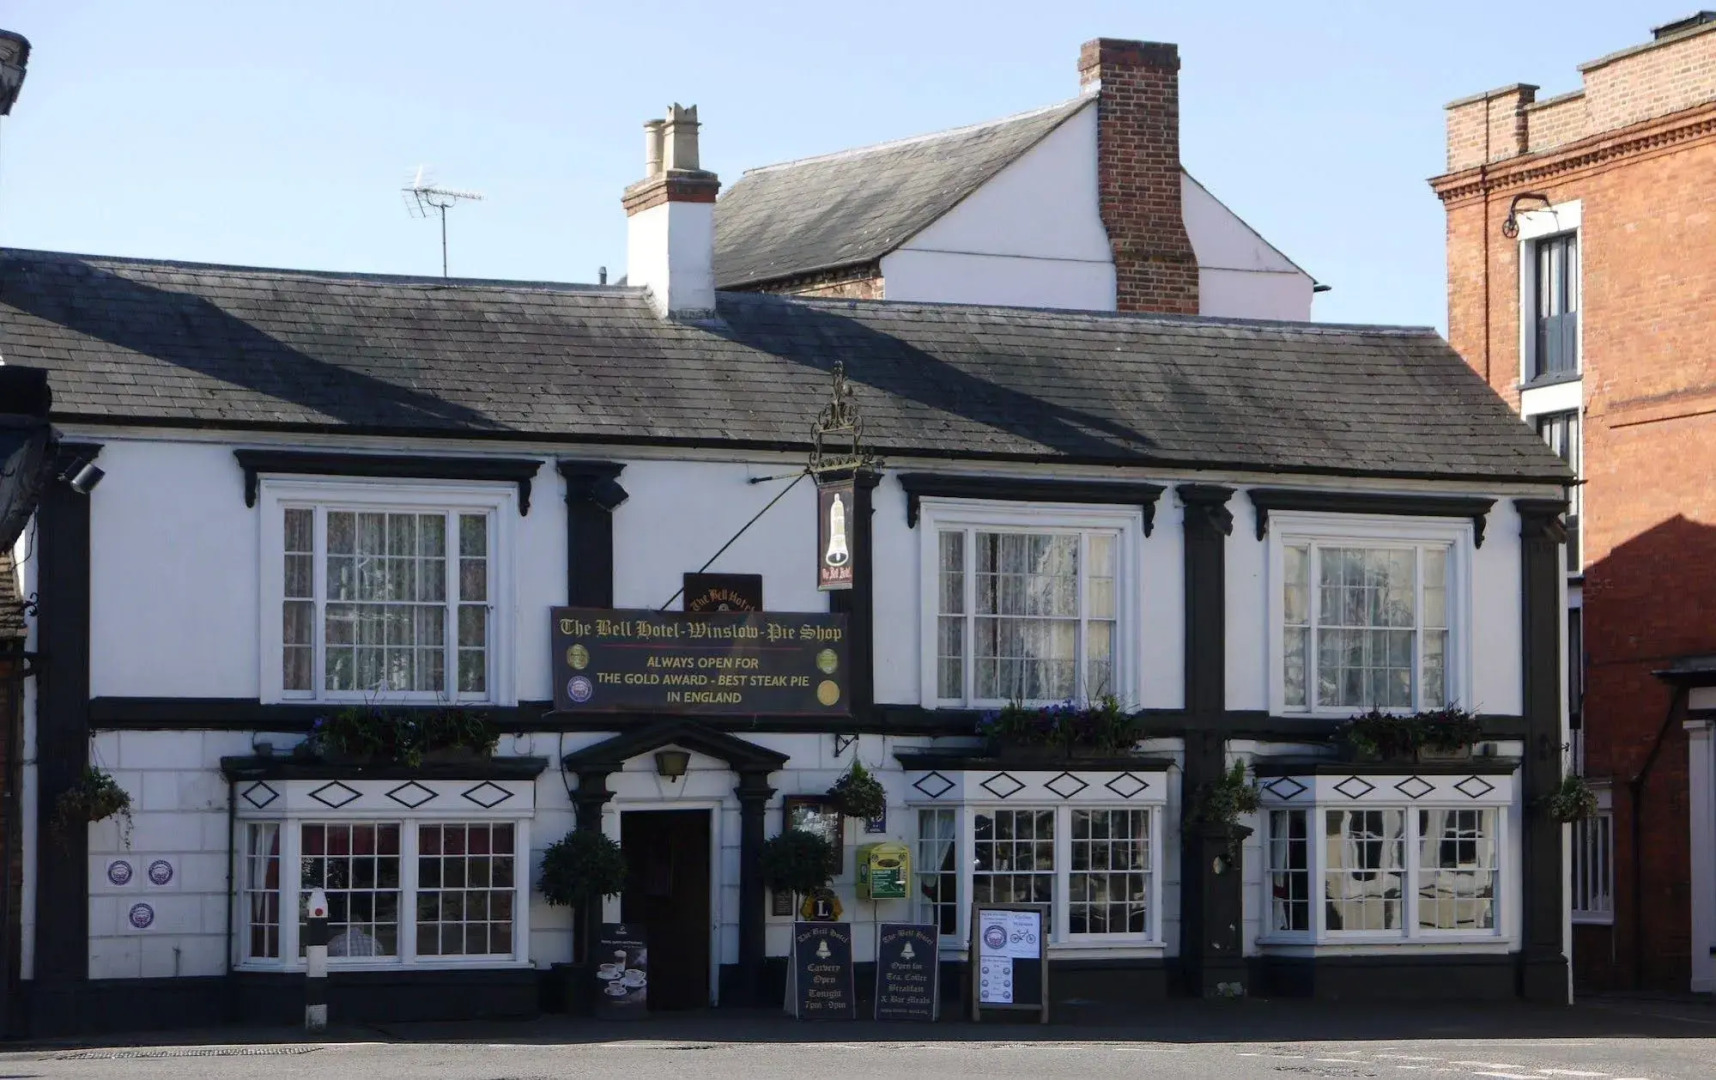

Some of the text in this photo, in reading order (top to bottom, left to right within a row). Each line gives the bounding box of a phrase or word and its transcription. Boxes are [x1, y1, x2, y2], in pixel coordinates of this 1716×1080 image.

[690, 594, 710, 612] The
[708, 588, 728, 602] Bell
[559, 618, 592, 638] The
[596, 619, 632, 638] Bell
[799, 624, 843, 642] Shop
[647, 656, 759, 669] ALWAYS OPEN FOR
[597, 673, 622, 684] THE
[624, 673, 660, 685] GOLD
[662, 674, 708, 685] AWARD
[717, 675, 748, 686] BEST
[750, 676, 787, 687] STEAK
[790, 676, 810, 687] PIE
[667, 692, 742, 704] IN ENGLAND
[817, 900, 829, 917] L
[897, 929, 914, 937] Bell
[807, 963, 841, 973] Carvery
[891, 962, 911, 970] Open
[813, 974, 836, 984] Open
[904, 973, 928, 981] Coffee
[808, 988, 842, 999] Tonight
[888, 984, 924, 993] Breakfast
